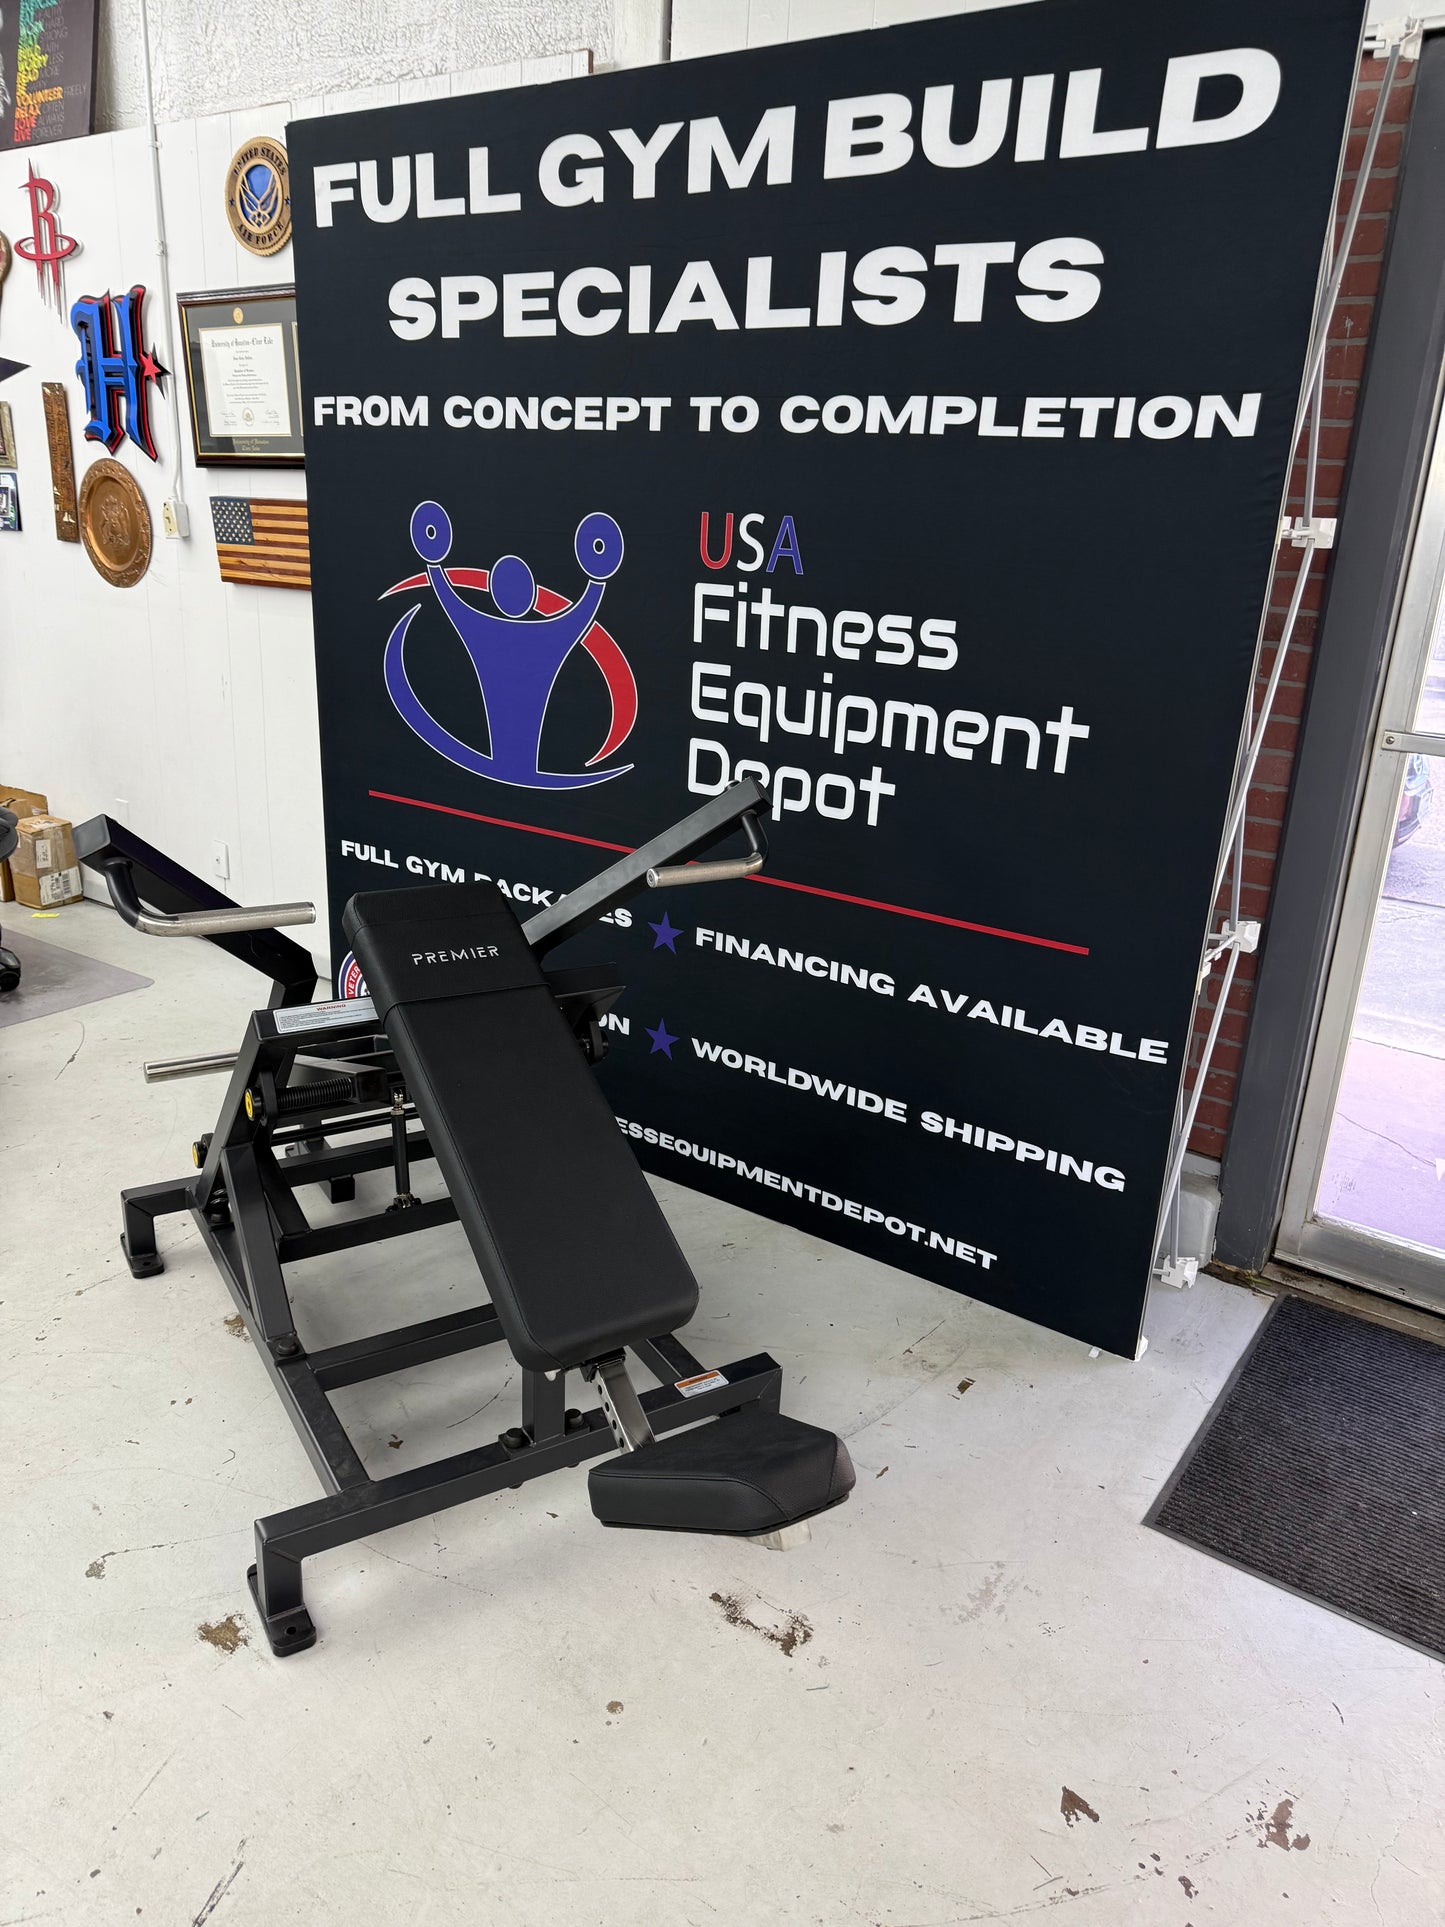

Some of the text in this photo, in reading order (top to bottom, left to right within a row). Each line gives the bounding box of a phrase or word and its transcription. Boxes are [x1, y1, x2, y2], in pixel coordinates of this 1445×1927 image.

[13, 128, 31, 142] LIVE
[14, 115, 37, 131] LOVE
[312, 47, 1282, 229] FULL GYM BUILD
[233, 146, 286, 176] UNITED STATES
[255, 222, 284, 244] FORCE
[388, 236, 1105, 341] SPECIALISTS
[313, 395, 429, 427] FROM
[443, 395, 672, 432] CONCEPT
[689, 395, 760, 434] TO
[779, 392, 1262, 440] COMPLETION
[700, 511, 804, 575] USA
[692, 581, 959, 671] Fitness
[690, 661, 1090, 775] Equipment
[341, 839, 399, 869] FULL
[405, 855, 465, 884] GYM
[348, 966, 361, 995] VETER
[411, 945, 499, 966] PREMIER
[695, 926, 1169, 1065] FINANCING AVAILABLE
[691, 1037, 1126, 1193] WORLDWIDE SHIPPING
[614, 1116, 999, 1270] ESSEQUIPMENTDEPOT.NET
